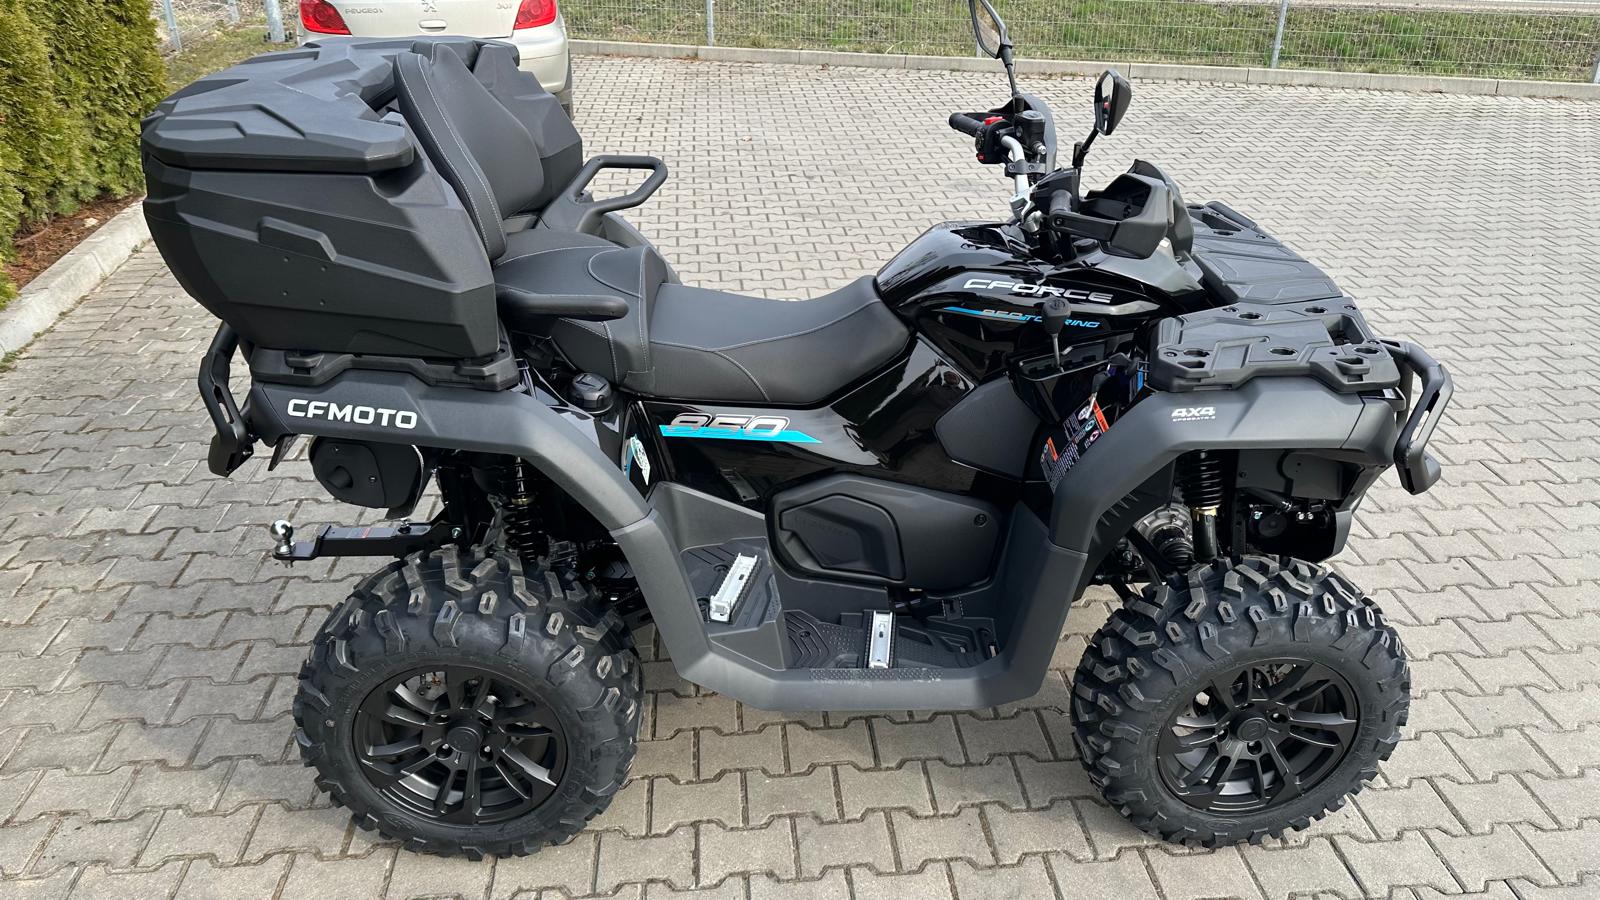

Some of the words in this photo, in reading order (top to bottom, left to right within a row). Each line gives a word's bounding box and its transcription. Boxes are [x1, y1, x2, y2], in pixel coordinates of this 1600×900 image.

[964, 278, 1114, 304] CFORCE
[1023, 314, 1100, 328] TORING
[287, 399, 418, 430] CFMOTO
